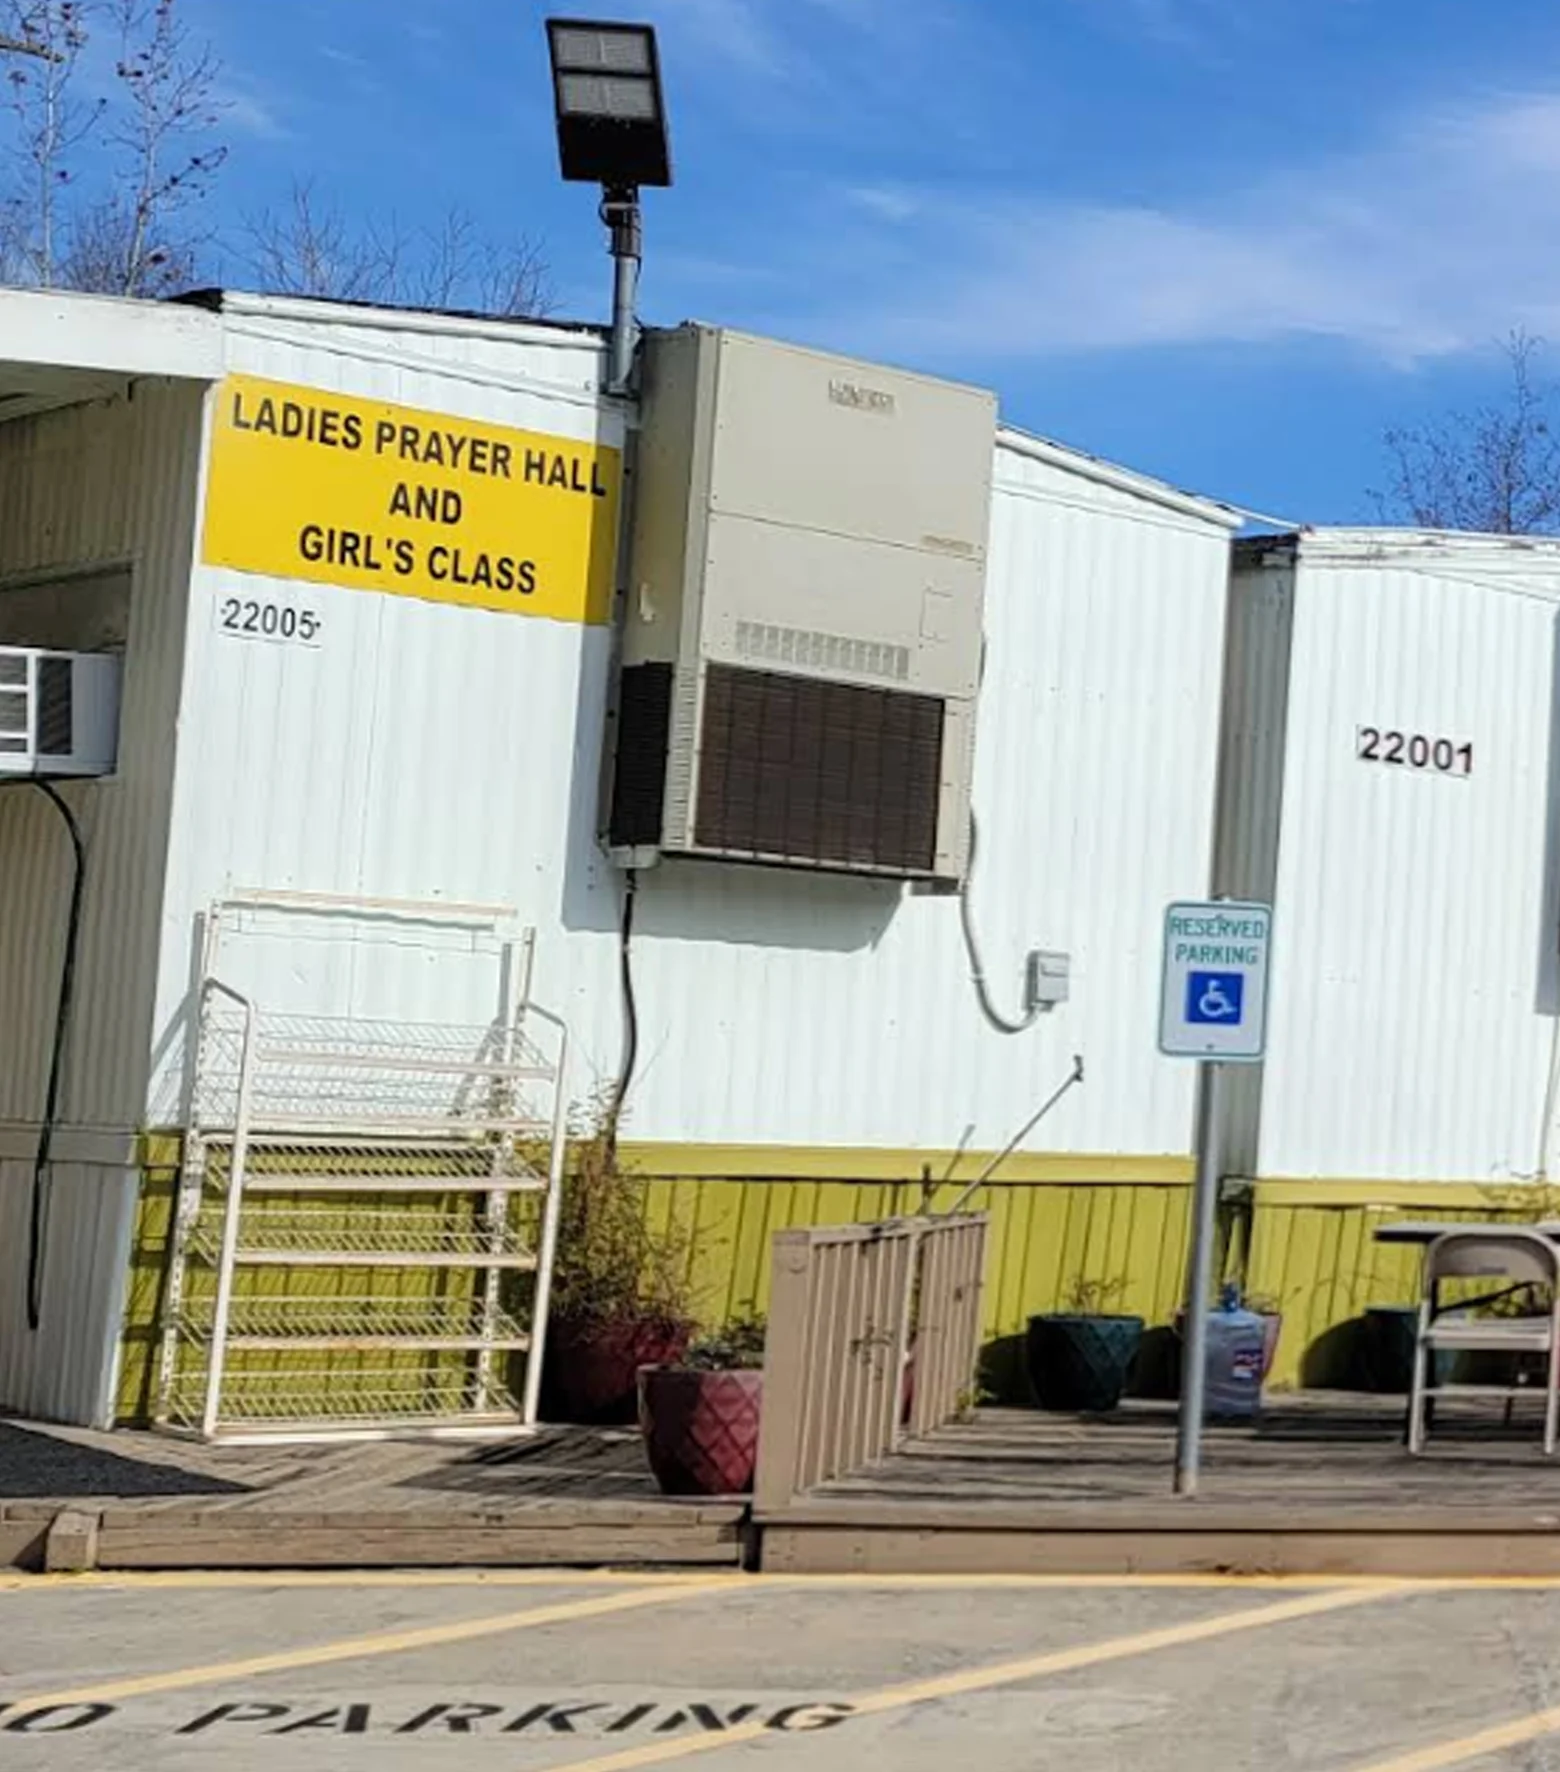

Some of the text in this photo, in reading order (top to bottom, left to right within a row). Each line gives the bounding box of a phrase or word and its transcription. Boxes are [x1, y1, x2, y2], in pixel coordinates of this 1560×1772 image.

[232, 394, 607, 497] LADIES PRAYER HALL
[389, 482, 462, 525] AND
[299, 525, 537, 595] GIRL'S CLASS
[222, 598, 315, 641] 22005
[1360, 727, 1473, 774] 22001
[1170, 915, 1264, 939] RESERVED
[1175, 943, 1258, 965] PARKING
[174, 1702, 857, 1734] PARKING
